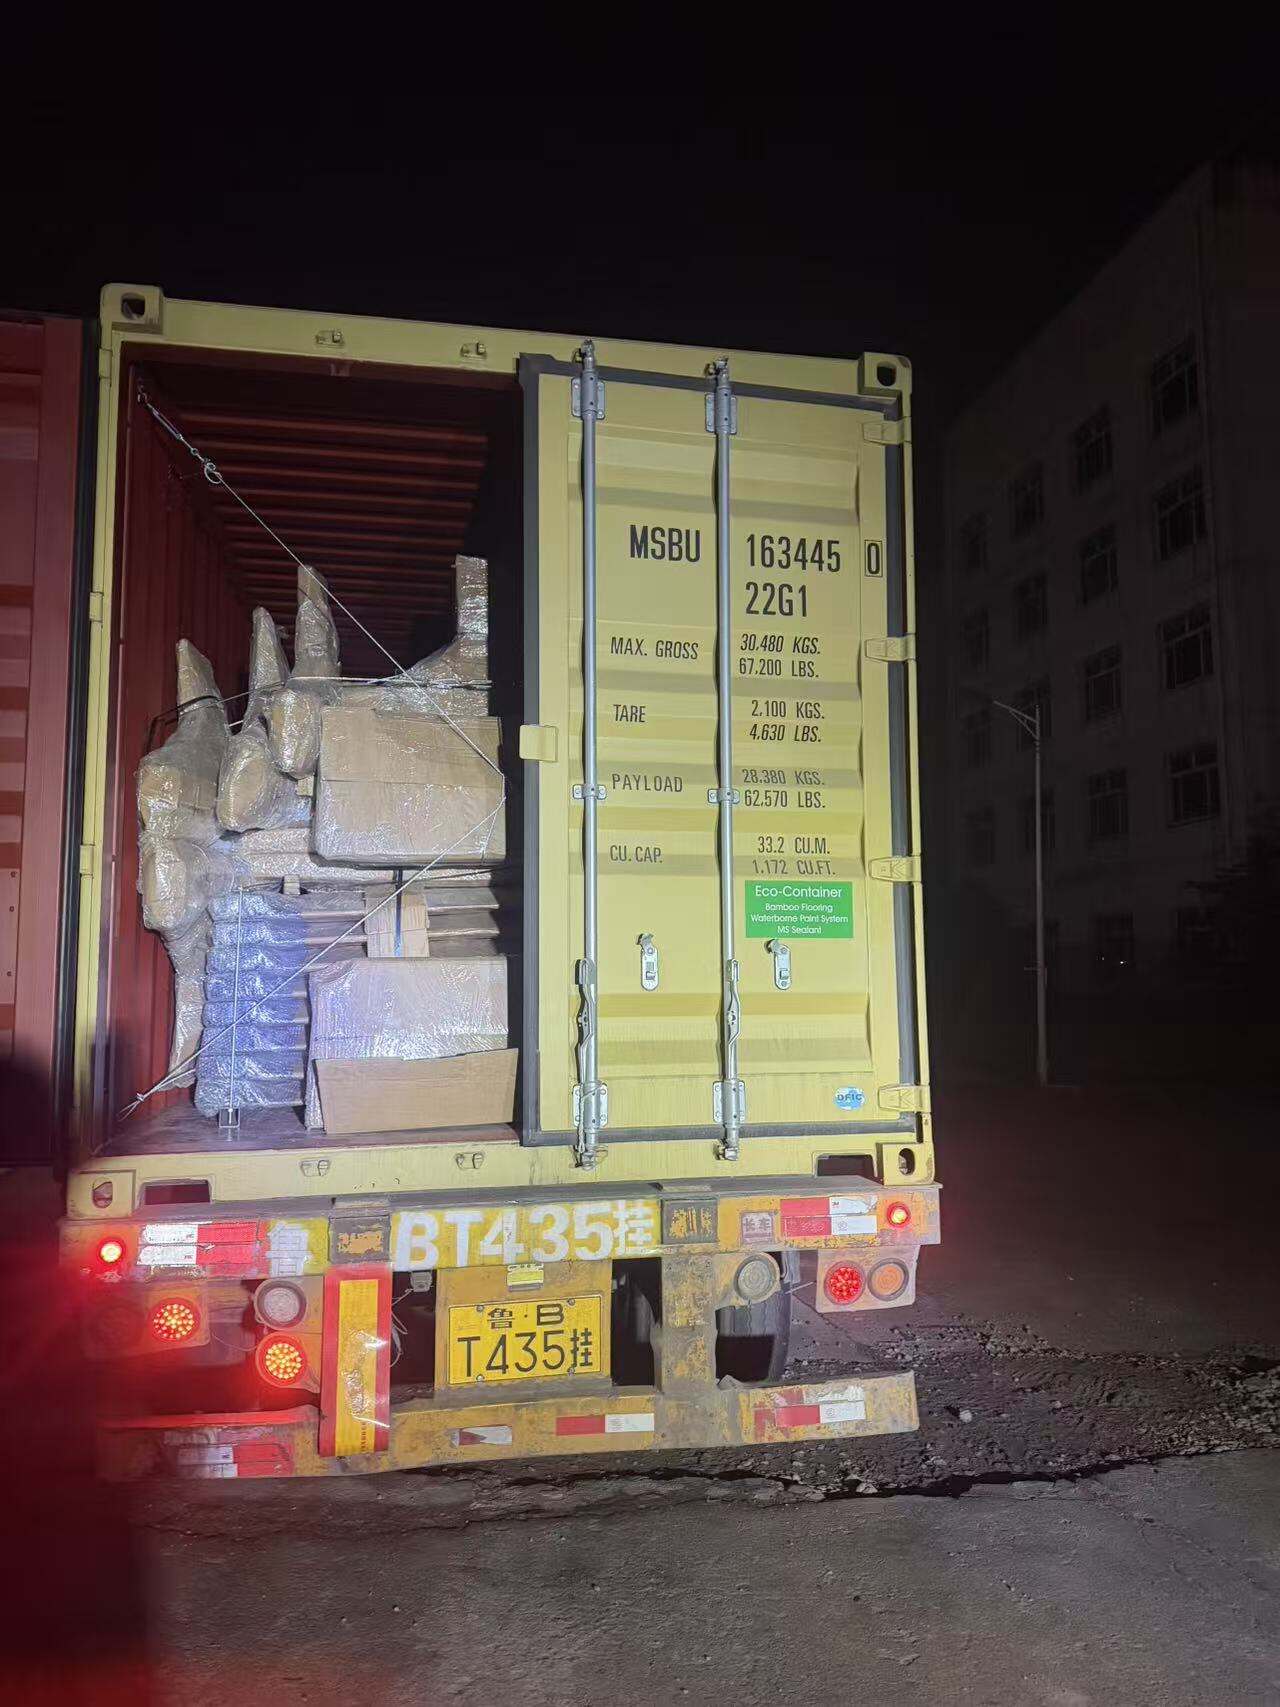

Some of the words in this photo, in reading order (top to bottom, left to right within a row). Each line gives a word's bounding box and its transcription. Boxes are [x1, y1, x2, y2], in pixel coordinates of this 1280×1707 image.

[630, 524, 701, 563] MSBU
[746, 533, 841, 573] 163445
[866, 542, 881, 575] 0
[745, 581, 807, 618] 22G1
[610, 636, 648, 656] MAX.
[655, 640, 699, 660] GROSS
[792, 635, 821, 655] KGS.
[791, 660, 819, 678] LBS.
[613, 704, 646, 723] TARE
[796, 701, 825, 720] KGS.
[794, 725, 822, 743] LBS.
[611, 773, 683, 793] PAYLOAD
[794, 770, 826, 786] KGS.
[798, 791, 826, 809] LBS.
[757, 835, 785, 854] 33.2
[794, 837, 831, 855] CU.M.
[796, 860, 836, 876] CU.FT.
[755, 885, 843, 898] Eco-Container
[765, 902, 800, 911] Bamboo
[801, 902, 834, 914] Flooring
[750, 913, 798, 923] Waterborne
[800, 914, 819, 923] Paint
[821, 914, 849, 924] System
[777, 925, 789, 934] MS
[791, 925, 822, 935] Sealant
[392, 1198, 655, 1273] BT435挂
[457, 1327, 594, 1378] T435挂
